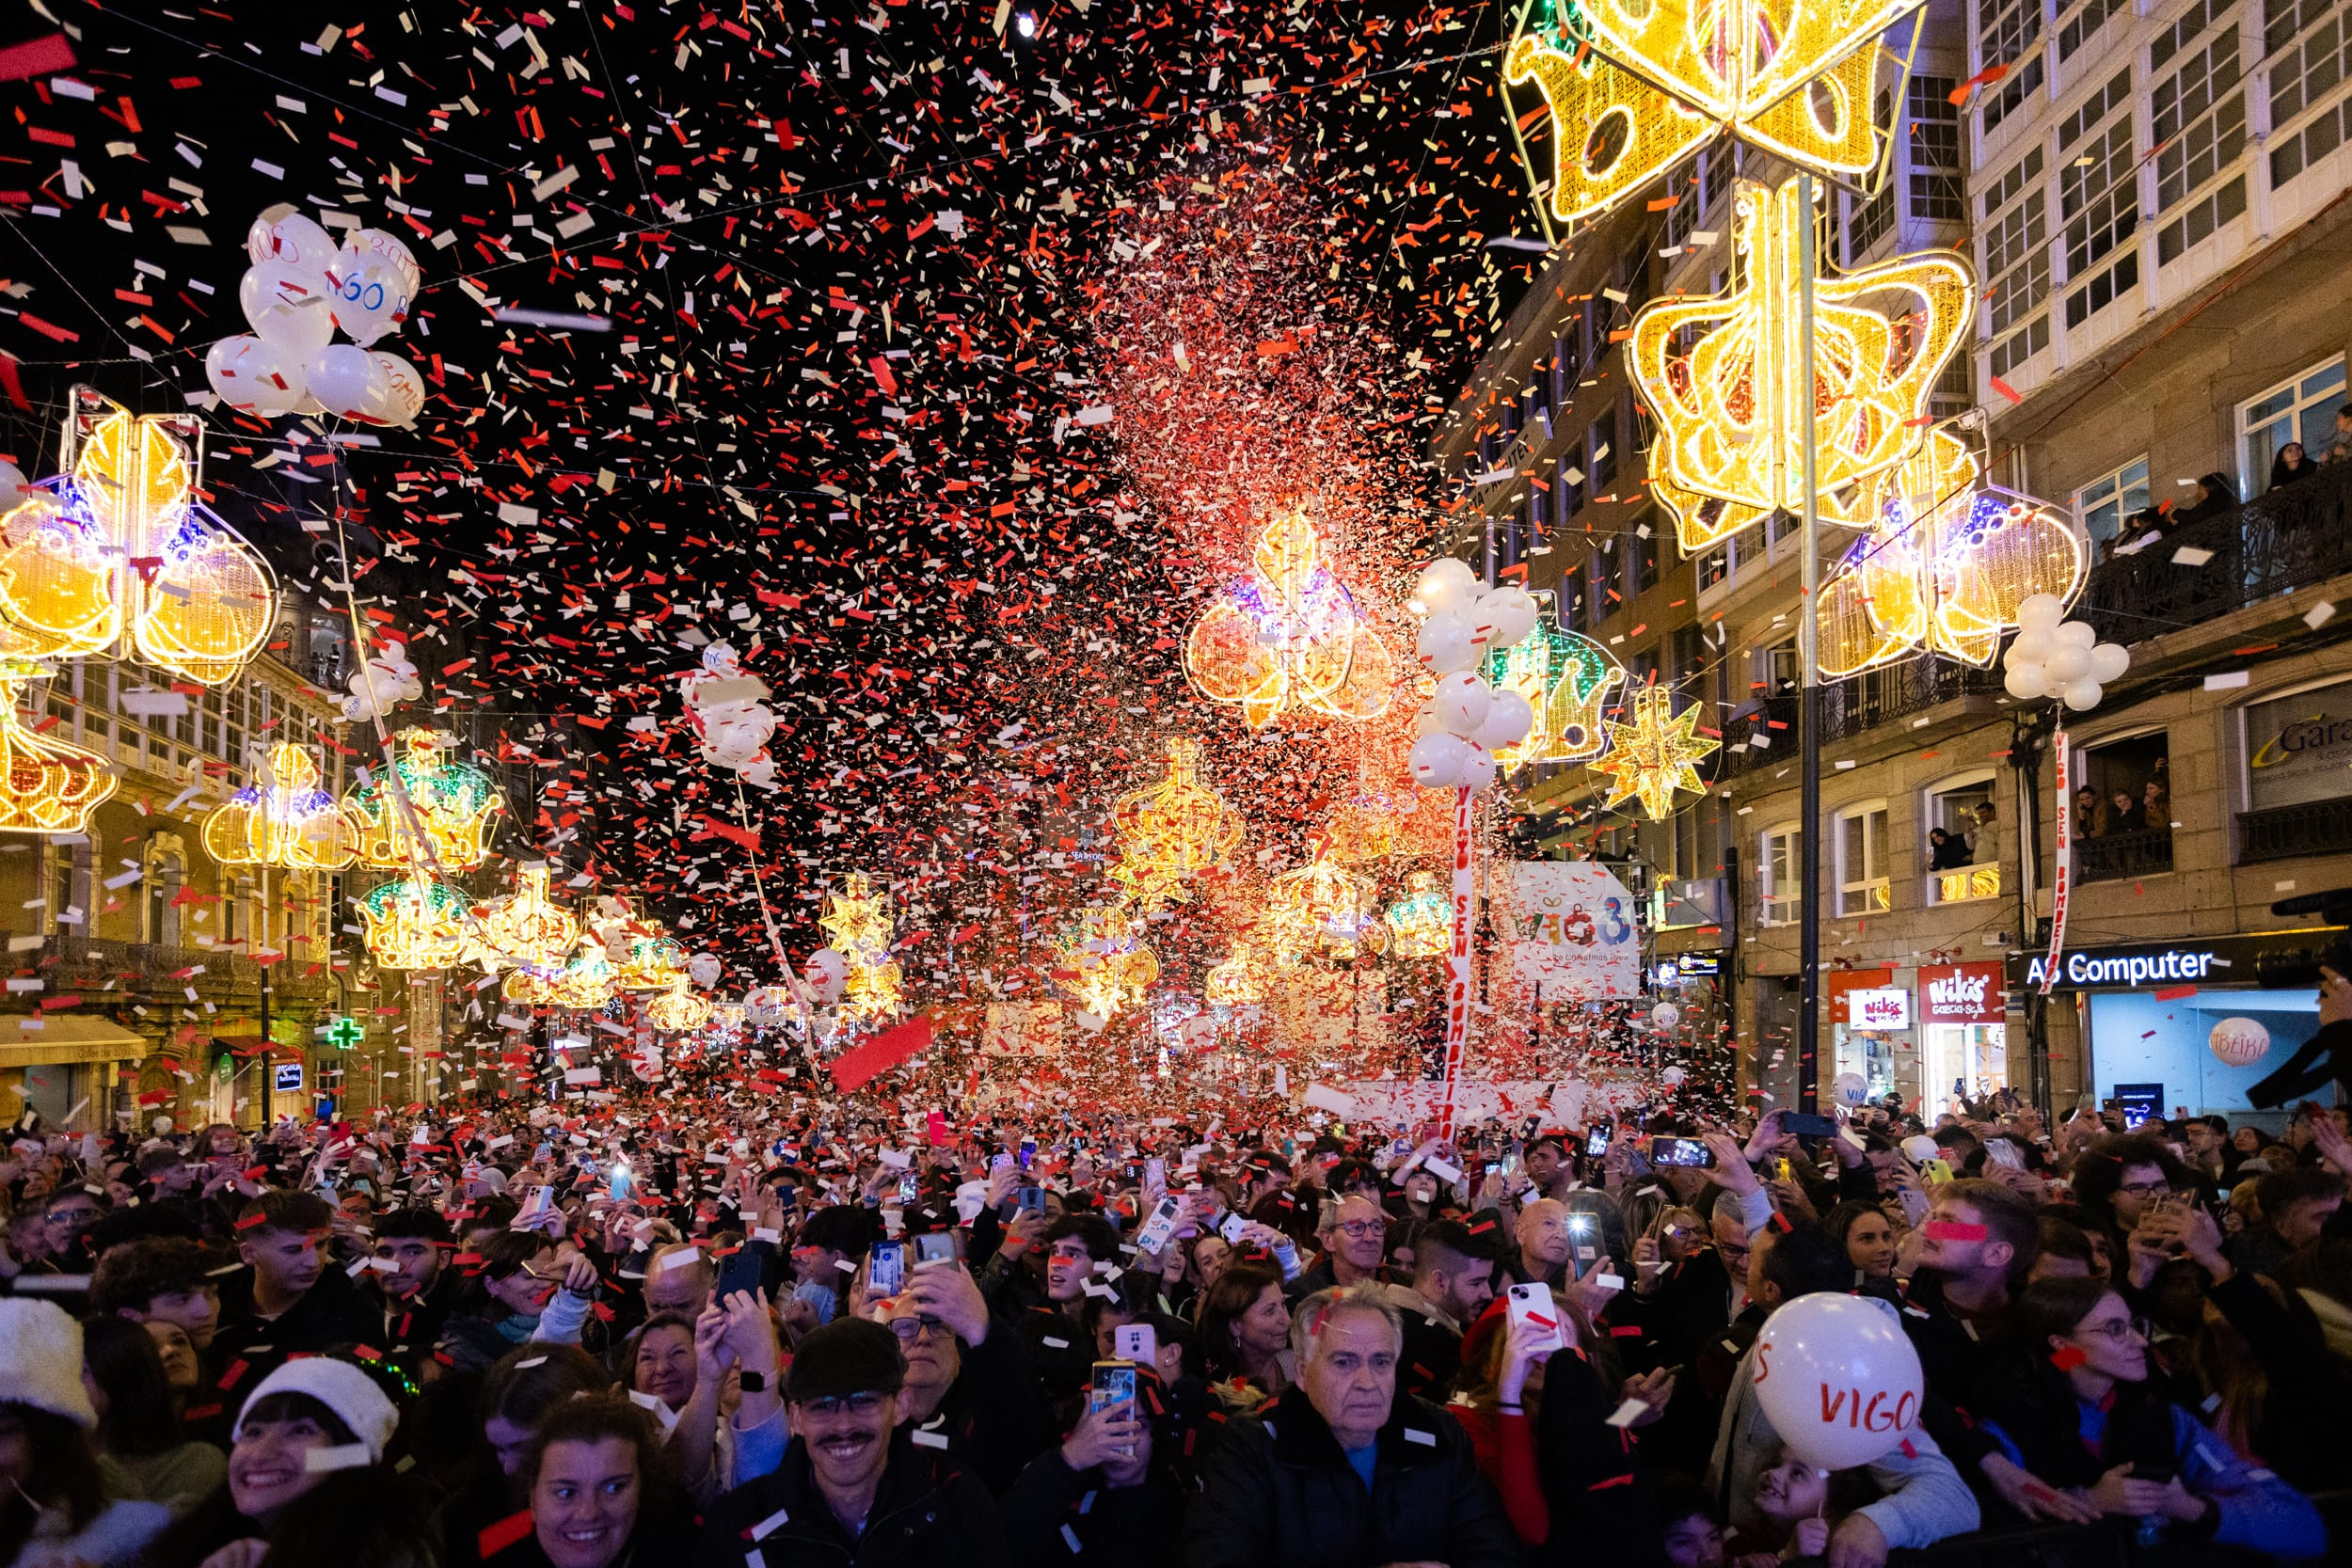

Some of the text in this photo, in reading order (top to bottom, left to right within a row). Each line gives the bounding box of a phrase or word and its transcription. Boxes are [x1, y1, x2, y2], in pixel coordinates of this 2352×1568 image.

[2057, 806, 2066, 849] SEN
[1454, 895, 1468, 958] SEN
[2041, 865, 2066, 993] BOMBEIROS
[1929, 969, 1985, 1004] Nikis
[2068, 952, 2214, 987] Computer
[1820, 1382, 1915, 1433] VIGO
